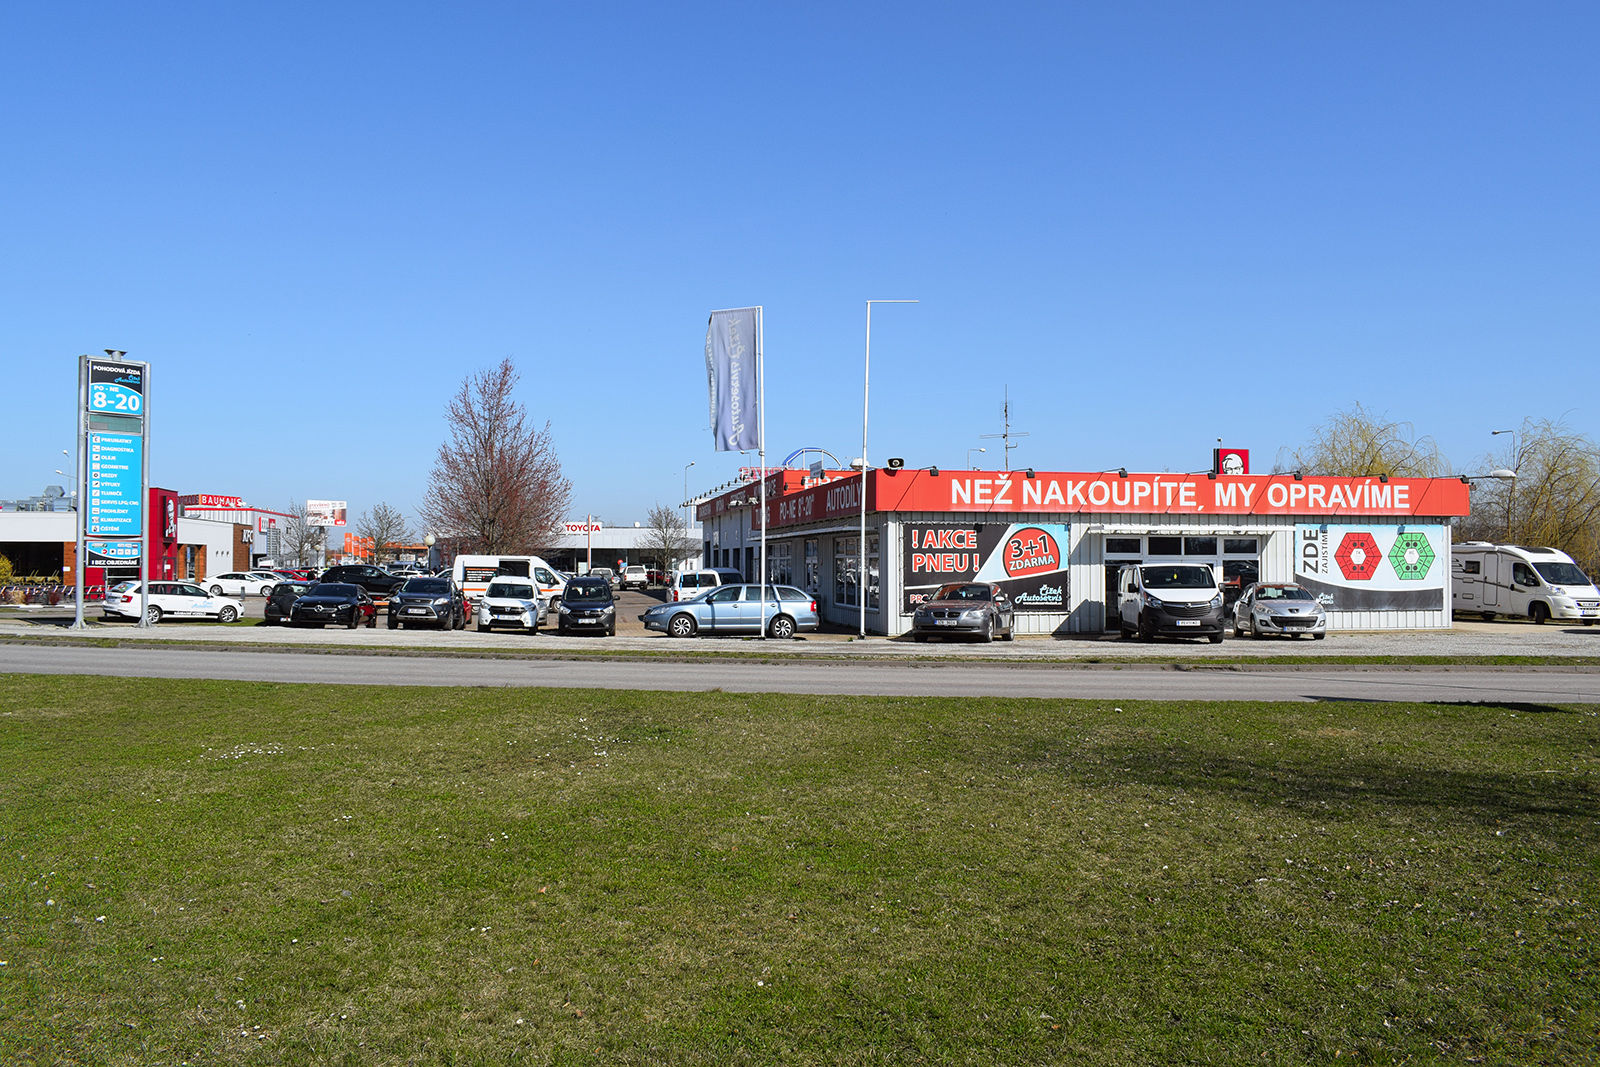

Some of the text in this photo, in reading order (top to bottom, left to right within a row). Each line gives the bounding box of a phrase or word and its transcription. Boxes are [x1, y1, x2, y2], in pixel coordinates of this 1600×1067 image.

[93, 365, 126, 374] POHODOVÁ
[93, 391, 140, 411] 8-20
[202, 495, 242, 506] BAUHAUS
[826, 478, 862, 512] AUTODÍLY
[951, 473, 1410, 511] NEŽ NAKOUPÍTE, MY OPRAVÍME
[242, 529, 253, 543] KFC
[565, 524, 601, 532] TOYOTA
[922, 529, 977, 549] AKCE
[1010, 534, 1049, 559] 3+1
[1303, 529, 1319, 574] ZDE
[912, 553, 969, 572] PNEU
[1009, 554, 1056, 571] ZDARMA
[1014, 592, 1063, 604] Autoservis
